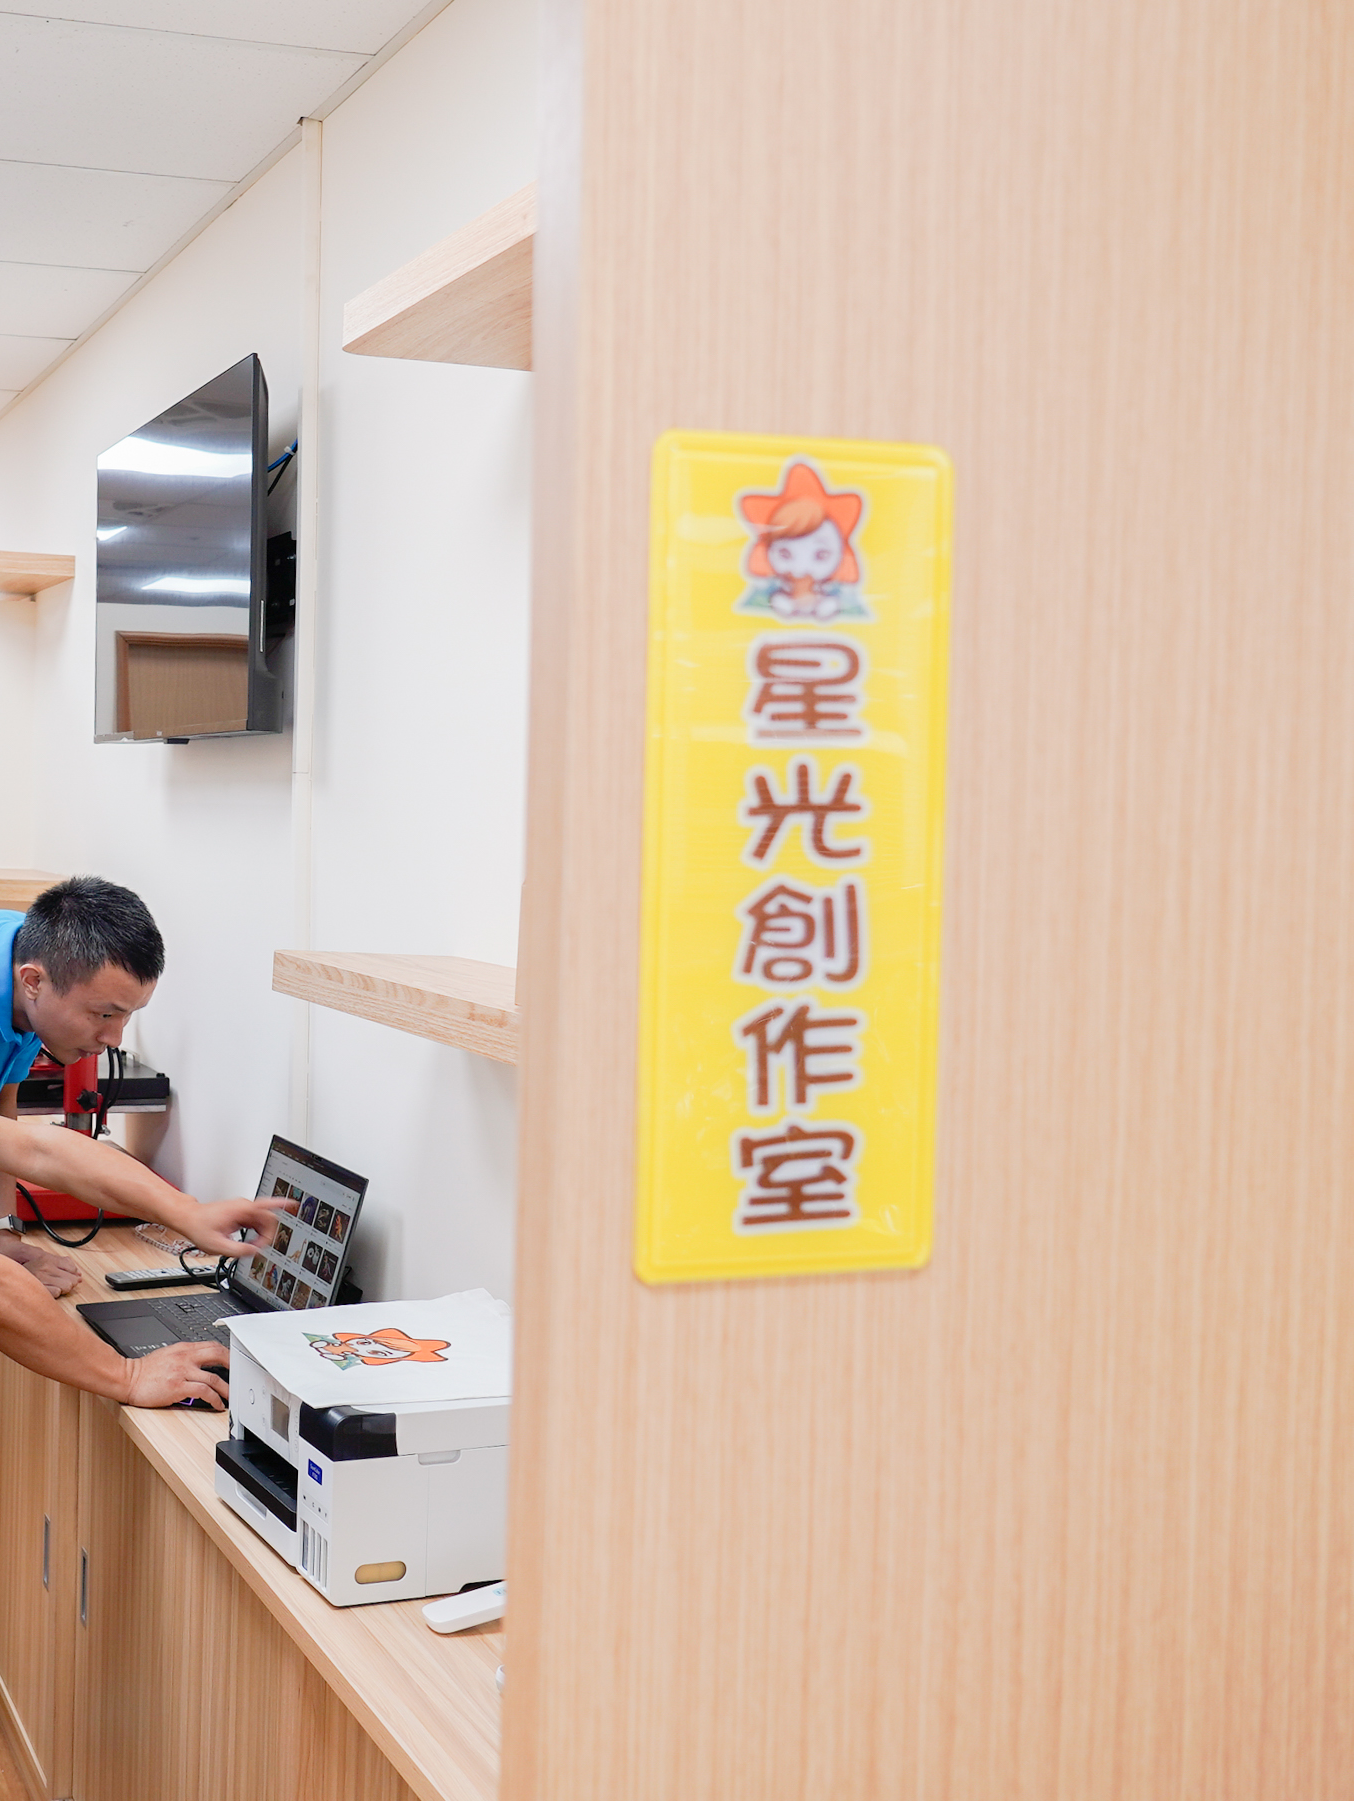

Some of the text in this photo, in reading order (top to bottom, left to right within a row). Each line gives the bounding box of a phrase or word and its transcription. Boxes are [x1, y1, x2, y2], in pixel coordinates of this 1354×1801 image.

[740, 641, 864, 1227] 星光創作室
